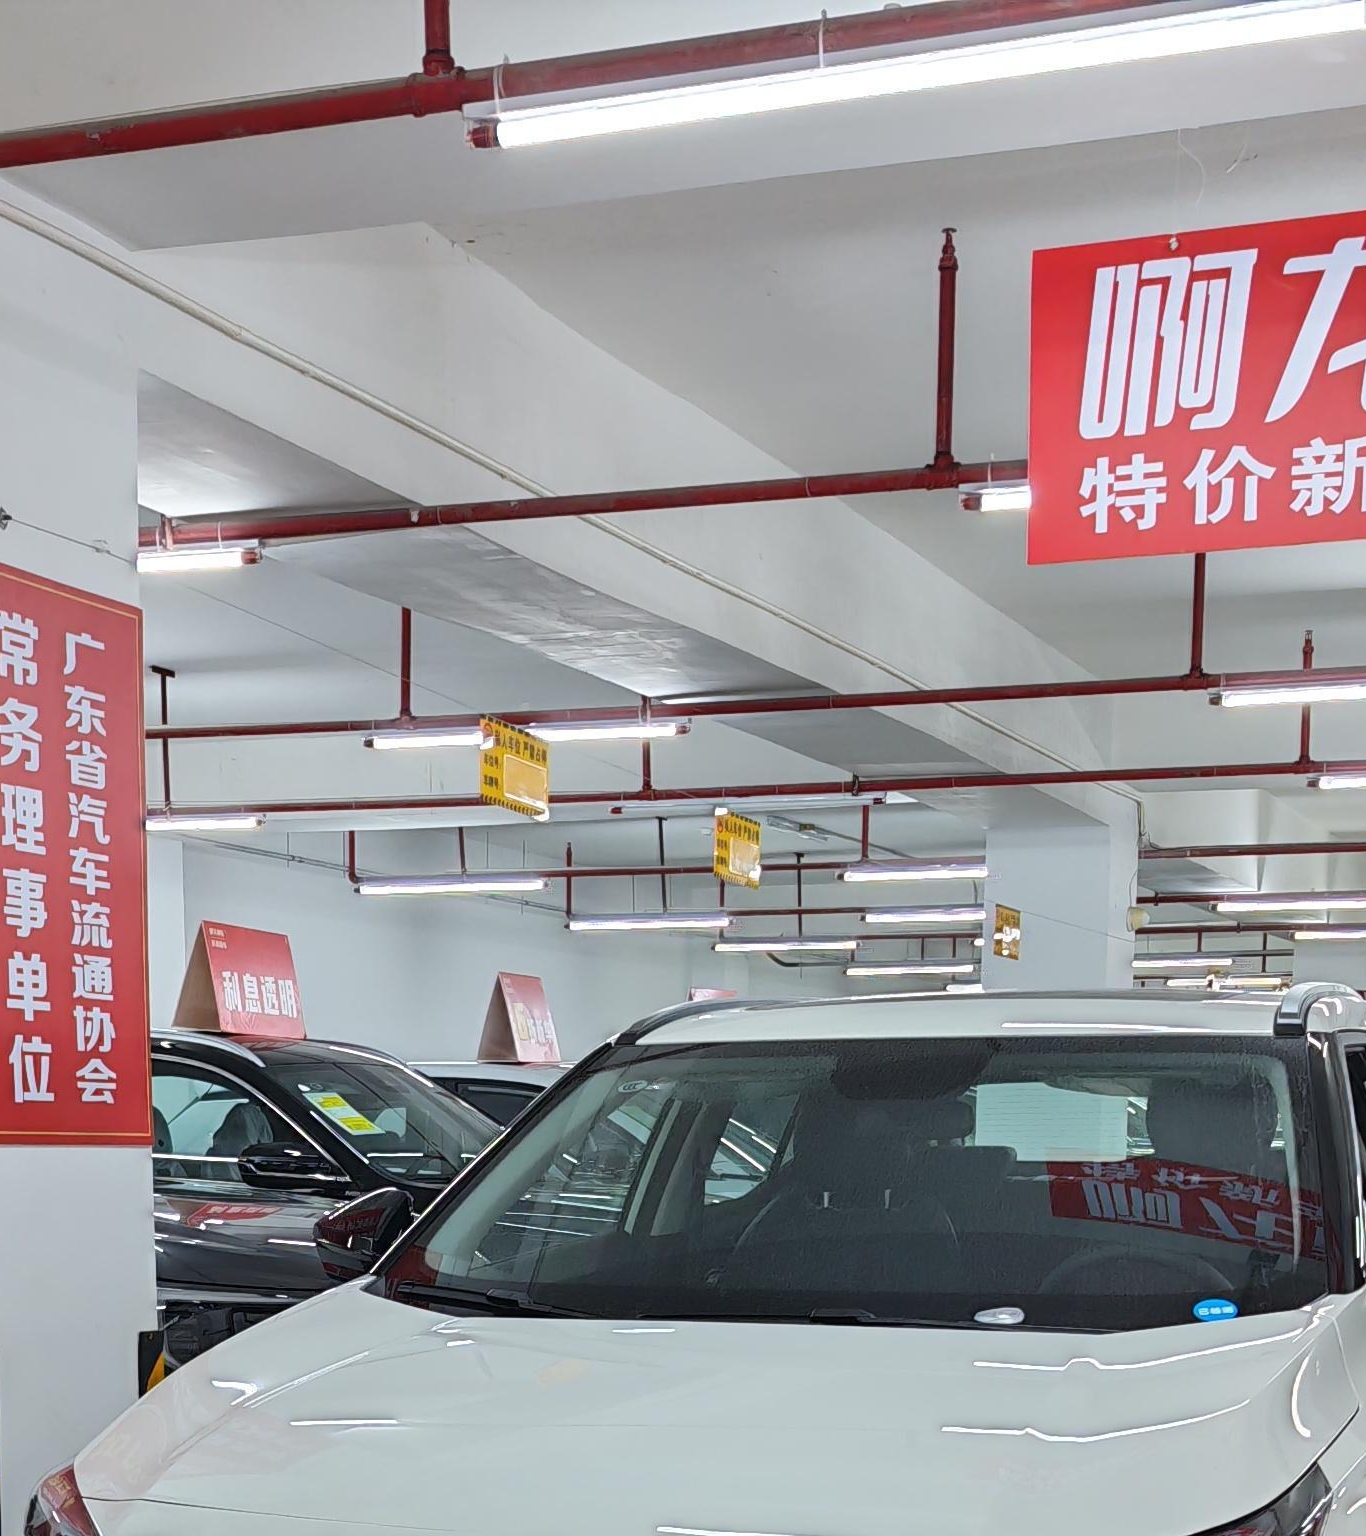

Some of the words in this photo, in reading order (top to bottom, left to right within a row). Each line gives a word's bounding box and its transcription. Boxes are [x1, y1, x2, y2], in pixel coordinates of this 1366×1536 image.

[63, 632, 117, 1105] 广东省汽车流通协会
[221, 970, 298, 1019] 利息透明
